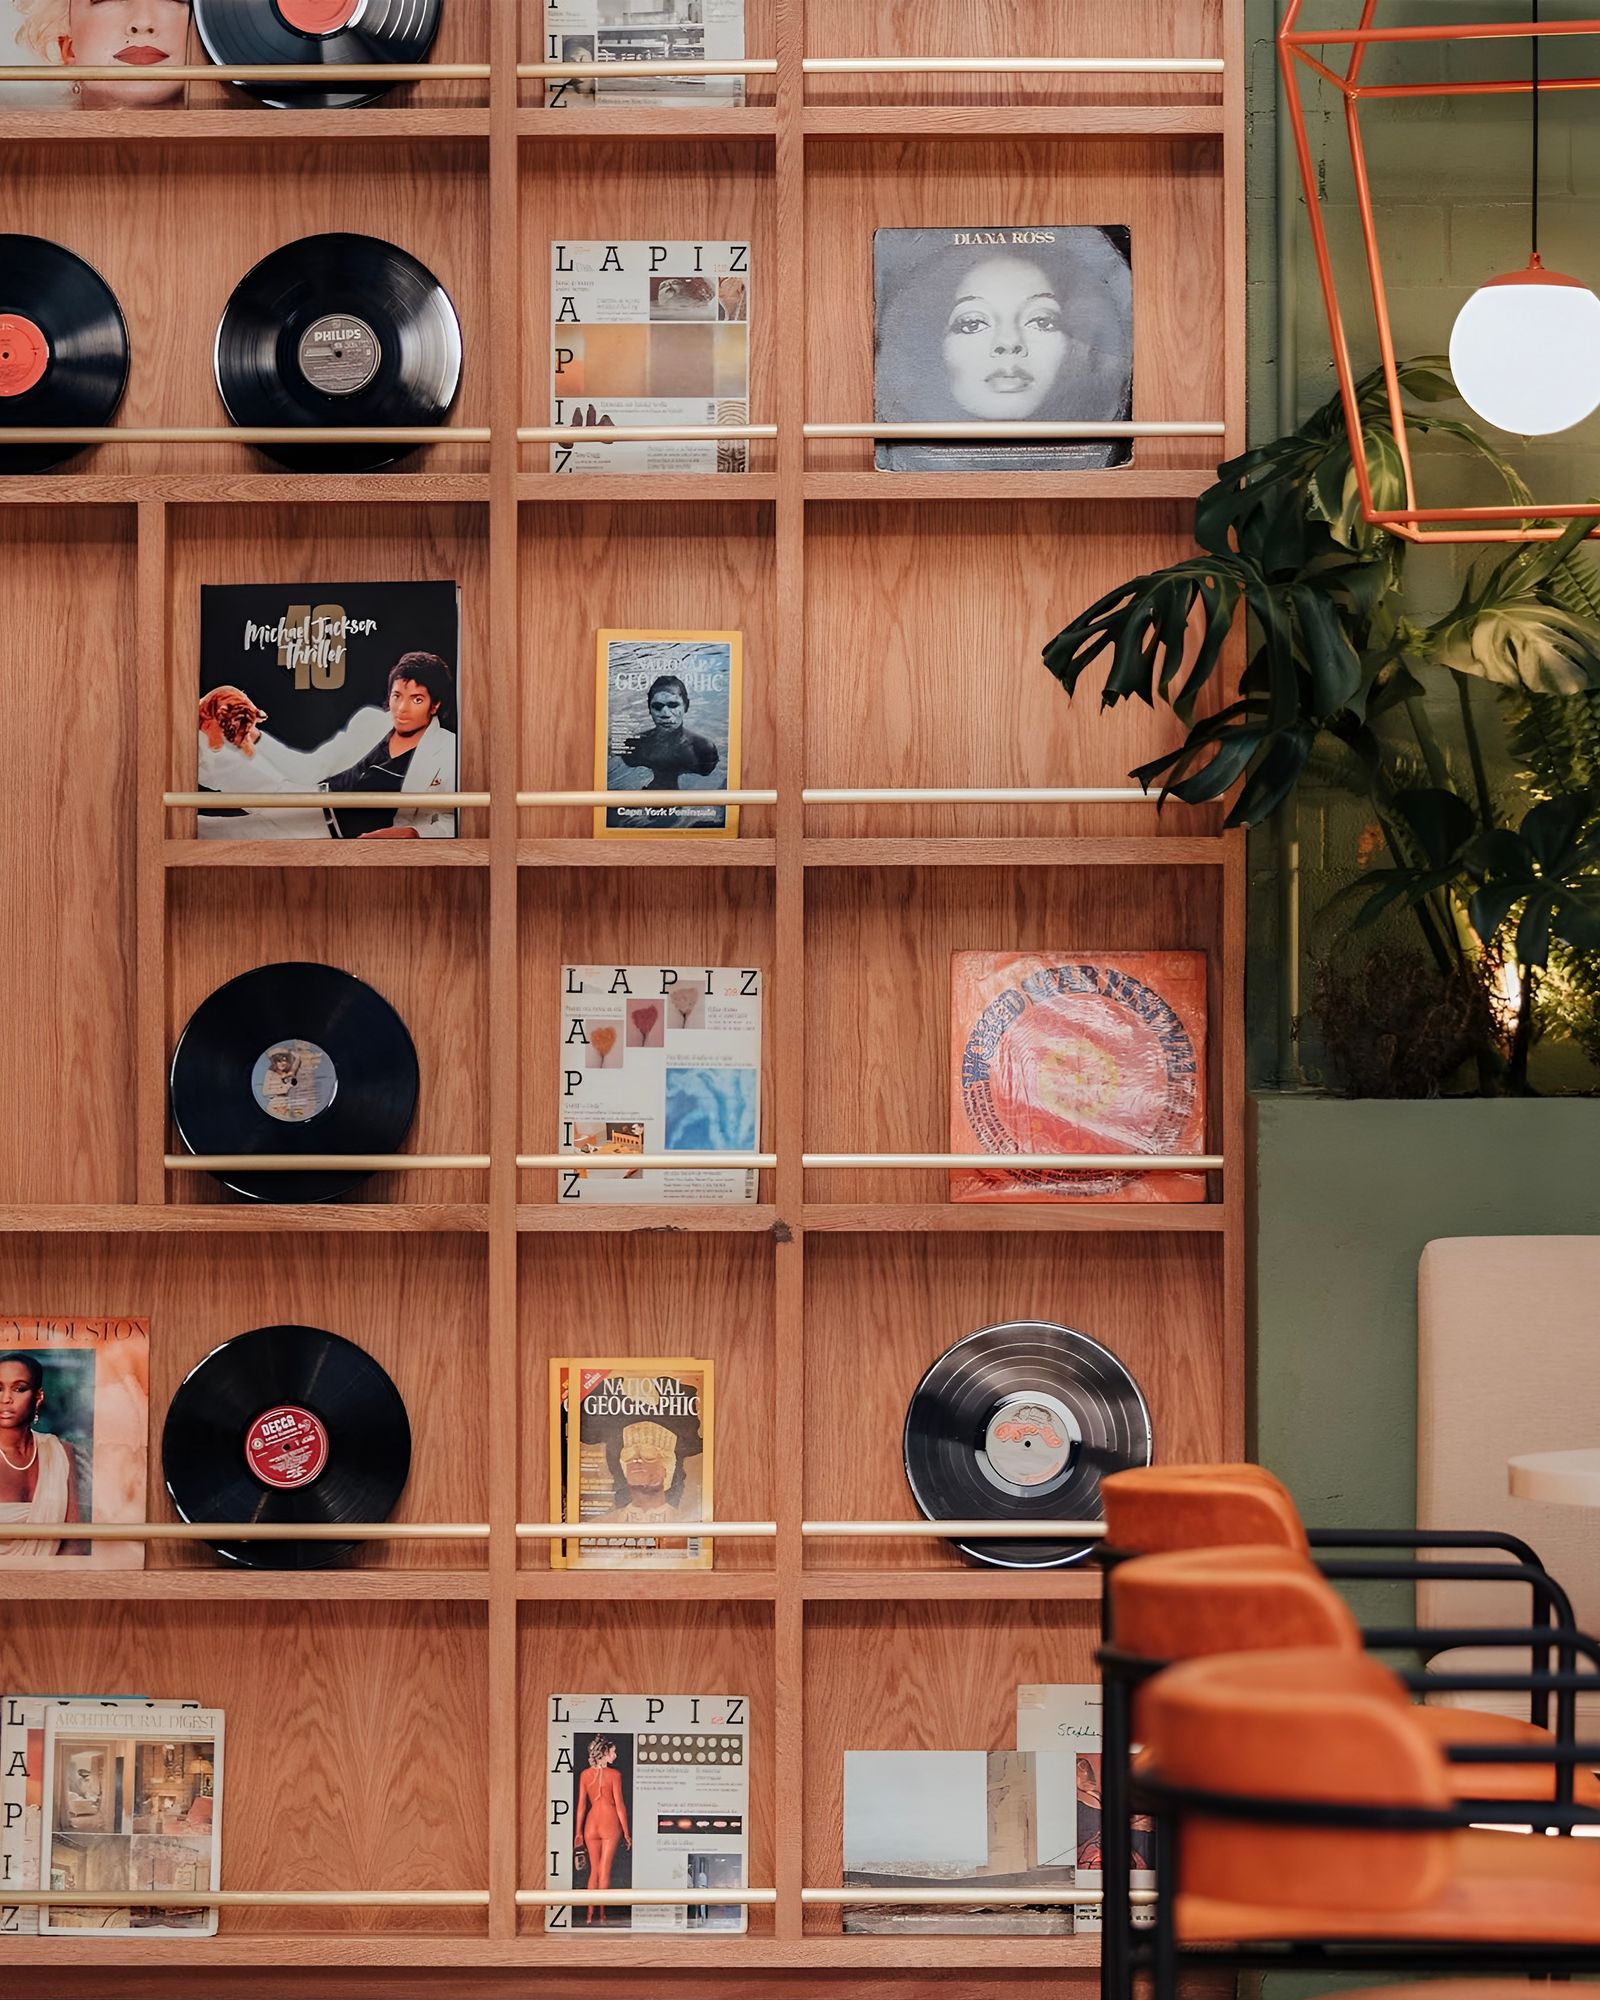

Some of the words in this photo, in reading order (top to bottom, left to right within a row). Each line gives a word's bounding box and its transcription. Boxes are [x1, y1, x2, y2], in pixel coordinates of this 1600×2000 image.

[953, 232, 1007, 246] DIANA
[1012, 231, 1056, 245] ROSS
[555, 245, 748, 272] LAPIZ
[314, 328, 362, 342] PHILIPS
[244, 616, 311, 650] Michael
[311, 615, 378, 644] Jackson
[644, 807, 668, 816] York
[565, 968, 758, 996] LAPIZ
[603, 1377, 686, 1396] NATIONAL
[583, 1394, 700, 1416] GEOGRAPHIC
[261, 1414, 296, 1437] DECCA
[55, 1713, 165, 1728] ARCHITECTURAL
[169, 1715, 216, 1729] DIGEST
[552, 1697, 745, 1724] LAPIZ
